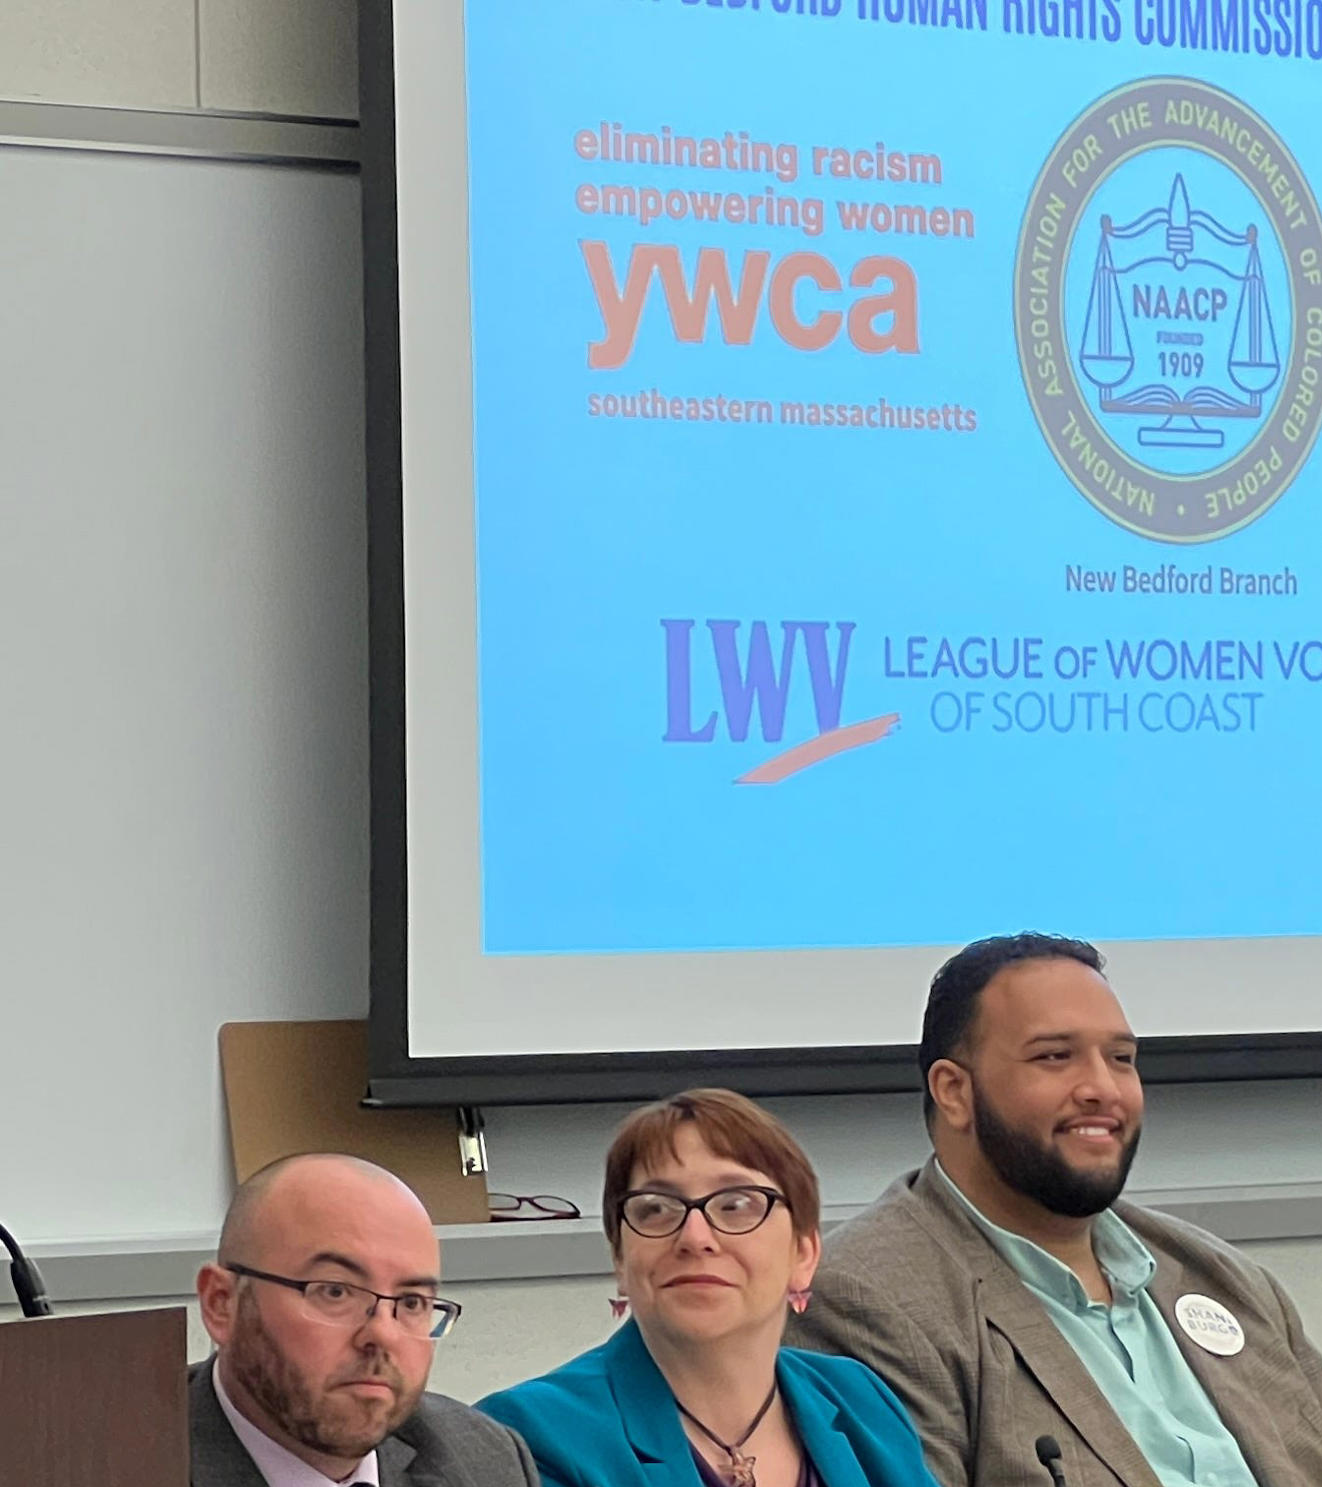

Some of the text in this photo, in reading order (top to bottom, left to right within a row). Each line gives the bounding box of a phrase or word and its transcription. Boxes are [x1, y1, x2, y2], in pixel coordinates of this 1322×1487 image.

[1107, 101, 1152, 140] THE
[574, 121, 942, 184] eliminating racism
[1061, 134, 1103, 188] FOR
[1165, 100, 1307, 231] ADVANCEMENT
[575, 182, 975, 239] empowering women
[1300, 247, 1322, 287] OF
[578, 239, 920, 370] ywca
[1030, 192, 1066, 397] ASSOCIATION
[1132, 283, 1228, 322] NAACP
[1158, 352, 1204, 378] 1909
[587, 390, 978, 433] southeastern massachusetts
[1062, 410, 1155, 517] NATIONAL
[1204, 451, 1283, 518] PEOPLE
[1066, 565, 1298, 597] New Bedford Branch
[660, 618, 857, 744] LWV
[884, 637, 1043, 680] LEAGUE
[1104, 641, 1263, 681] WOMEN
[930, 693, 1263, 734] OF SOUTH COAST
